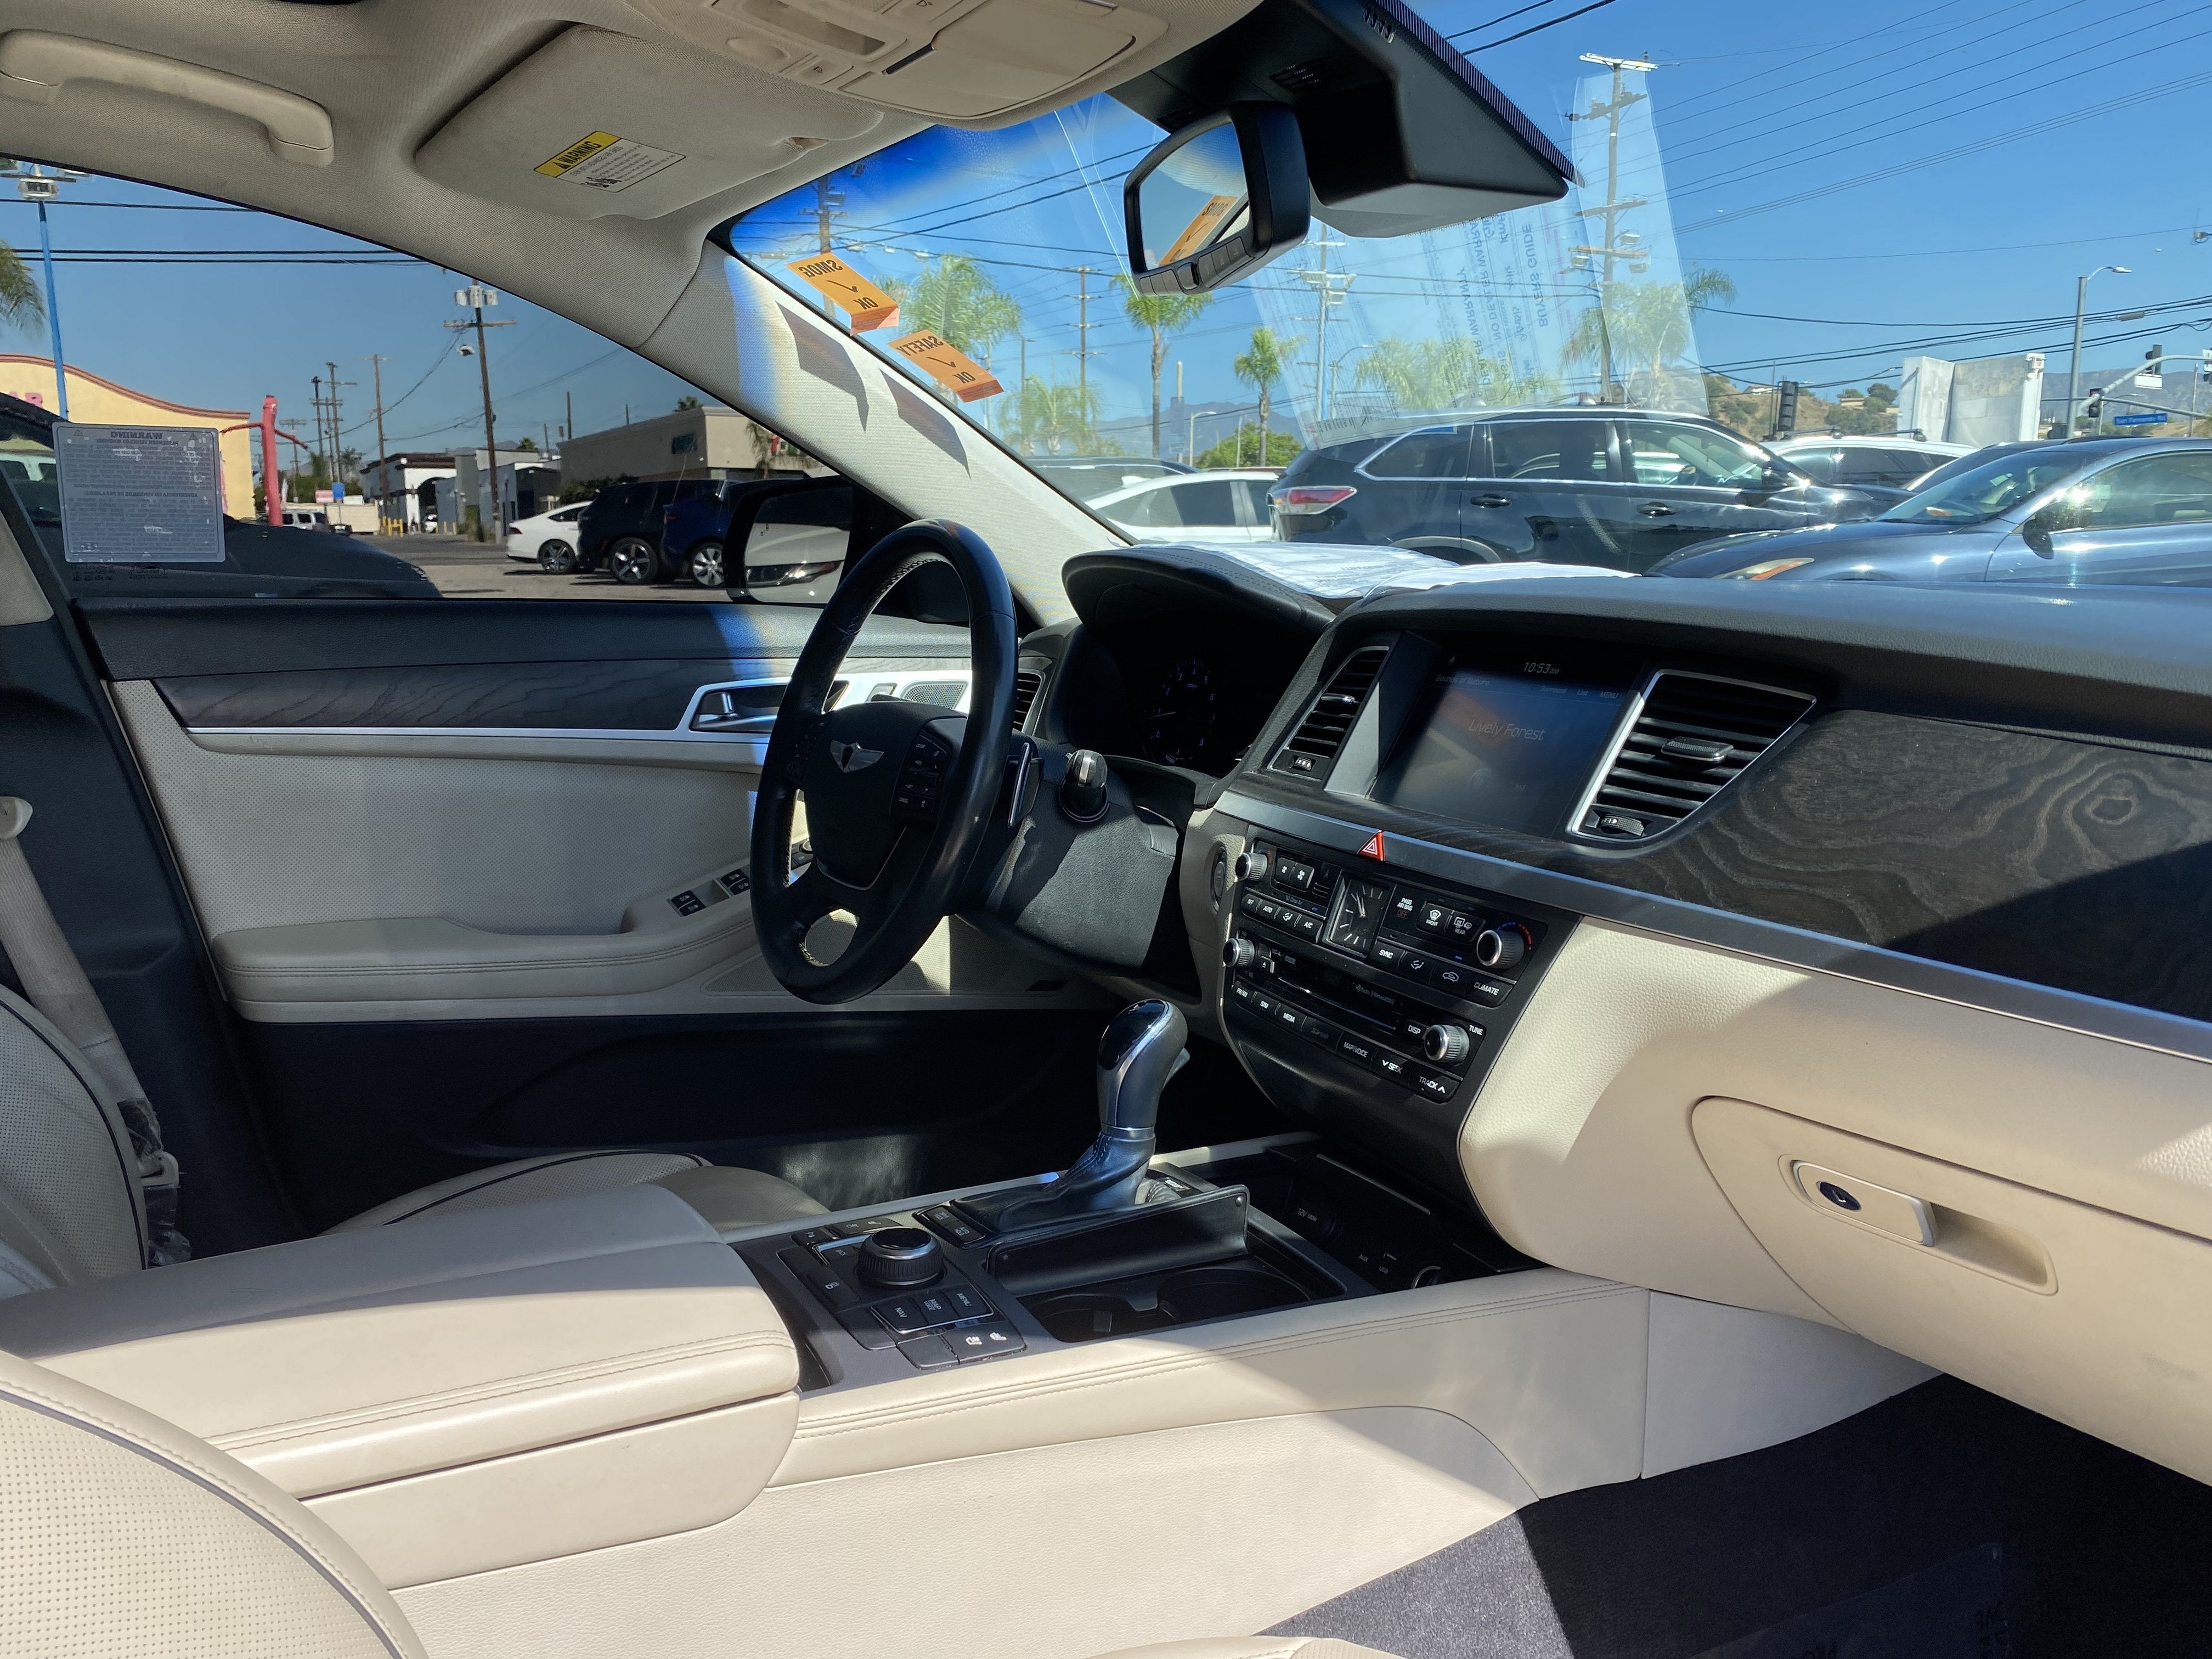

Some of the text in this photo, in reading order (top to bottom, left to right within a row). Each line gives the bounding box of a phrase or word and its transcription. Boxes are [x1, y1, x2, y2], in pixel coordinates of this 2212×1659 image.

[557, 141, 602, 166] WARNING
[1436, 674, 1490, 687] Sounds of Nature
[1577, 689, 1588, 697] List
[1599, 691, 1618, 699] MENU
[1468, 719, 1546, 742] Lively Forest
[1262, 905, 1273, 913] AUTO
[1397, 910, 1408, 919] OFF
[1304, 921, 1313, 929] A/C
[1379, 949, 1393, 959] SYNC
[1474, 982, 1499, 996] CLIMATE
[1283, 1013, 1295, 1023] MEDIA
[1408, 1025, 1421, 1035] DISP
[1469, 1024, 1483, 1036] TUNE
[1419, 1076, 1438, 1090] TRACK
[1297, 1207, 1307, 1217] 12V
[1359, 1254, 1369, 1263] AUX
[929, 1299, 942, 1310] MAP
[957, 1293, 972, 1307] MENU
[895, 1307, 908, 1318] NAV
